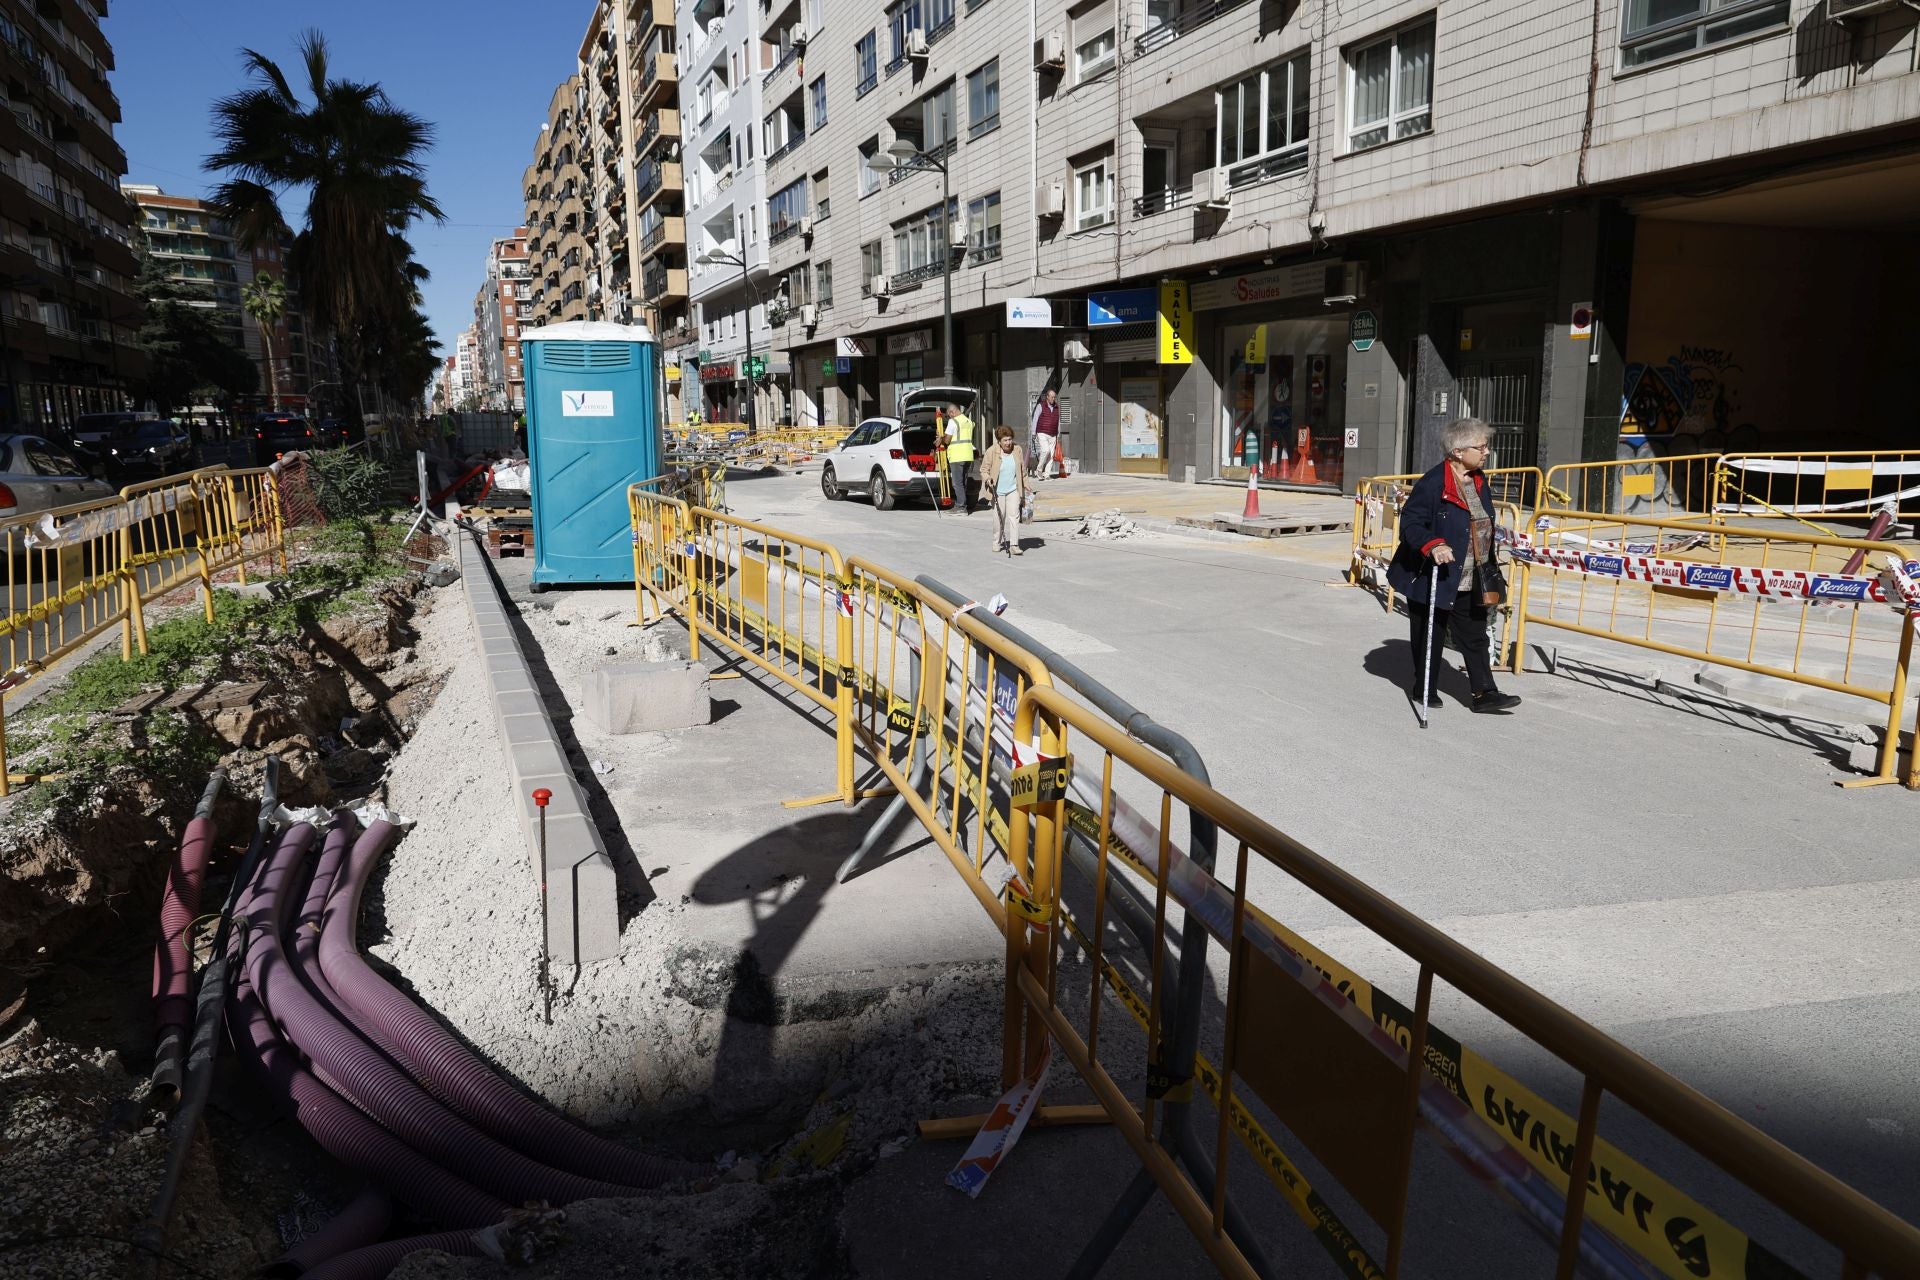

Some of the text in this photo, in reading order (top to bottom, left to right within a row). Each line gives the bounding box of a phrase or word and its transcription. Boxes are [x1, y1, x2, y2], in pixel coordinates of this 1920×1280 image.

[1249, 286, 1280, 300] Saludes
[1118, 306, 1138, 317] ama
[1172, 289, 1181, 361] SALUDES
[1589, 557, 1619, 570] Bertolín
[1652, 567, 1660, 576] NO
[1661, 568, 1680, 577] PASAR
[1690, 568, 1727, 582] Bertolín
[1768, 578, 1778, 588] NO
[1780, 579, 1802, 590] PASAR
[1813, 580, 1861, 595] Bertolín
[892, 712, 910, 728] NO
[1056, 768, 1067, 789] O
